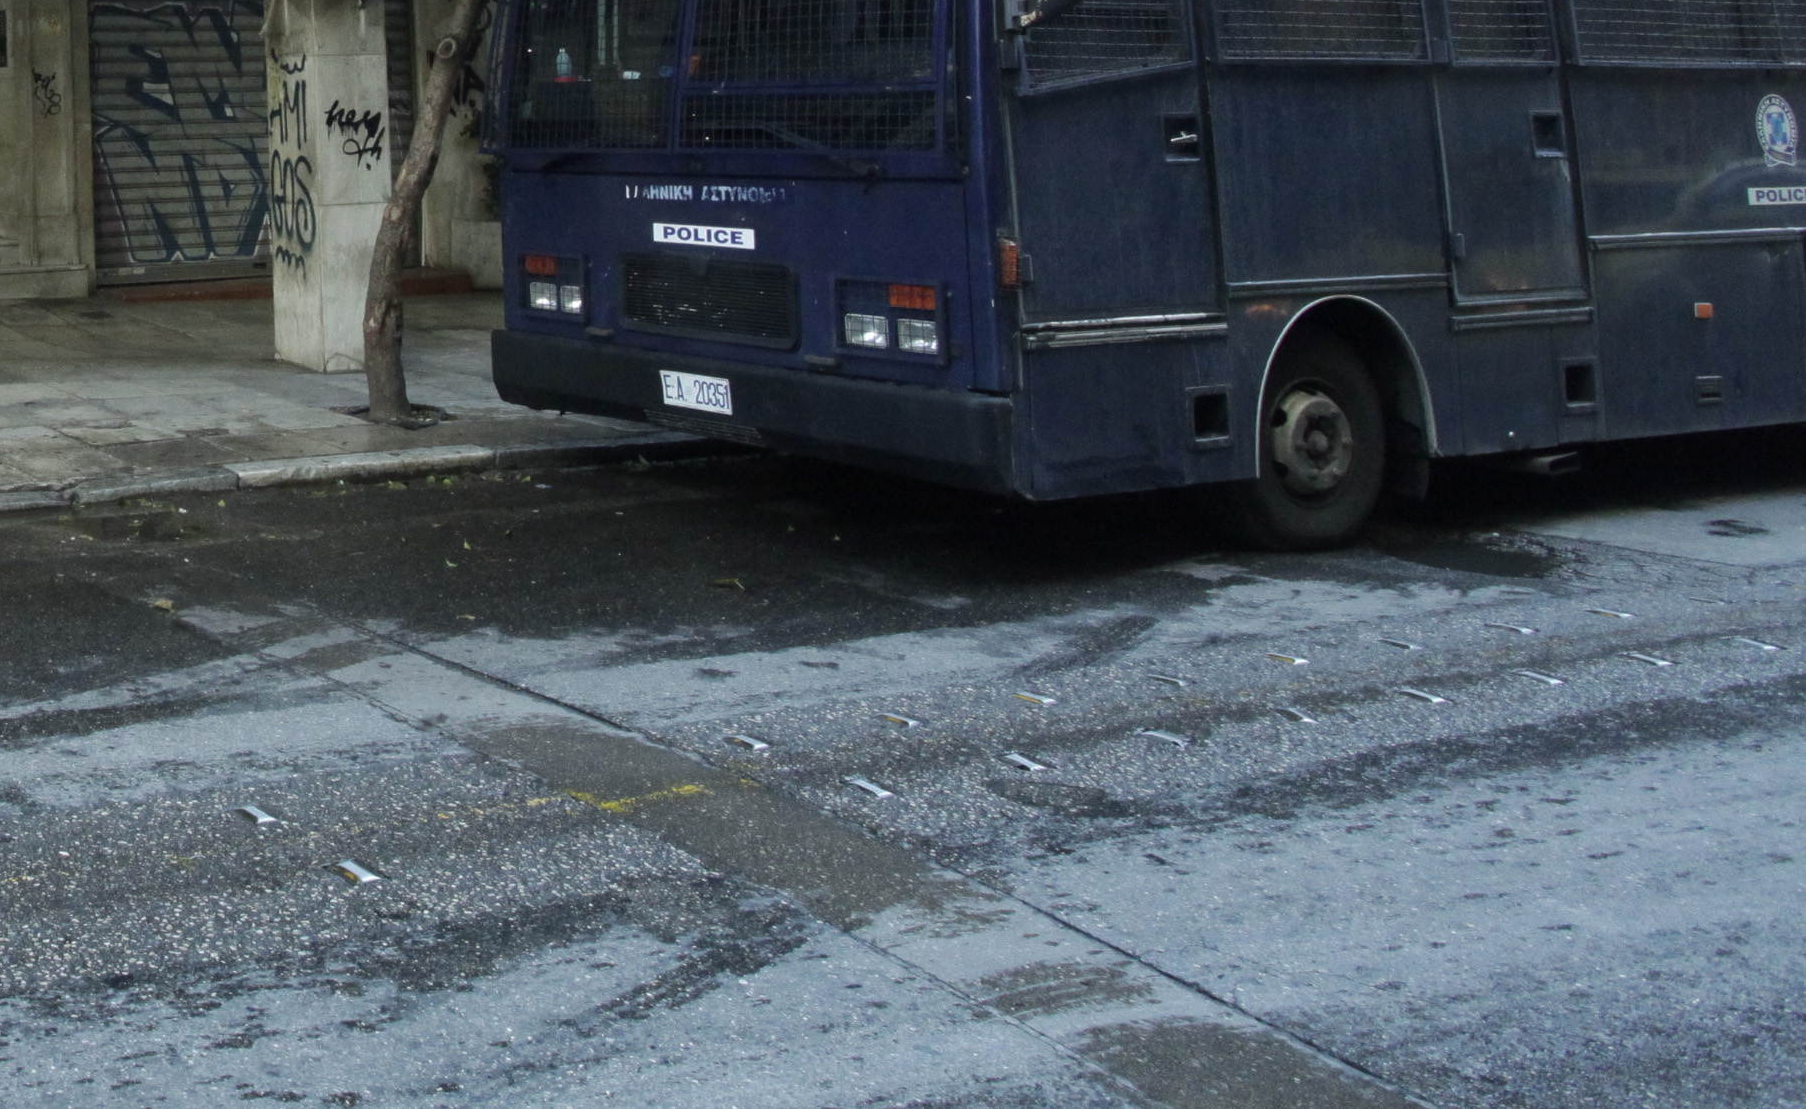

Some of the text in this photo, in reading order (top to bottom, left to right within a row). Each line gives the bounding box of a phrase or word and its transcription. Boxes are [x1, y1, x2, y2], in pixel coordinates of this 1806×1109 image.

[1755, 189, 1806, 203] POLIC
[663, 226, 744, 246] POLICE
[694, 380, 730, 410] 20351
